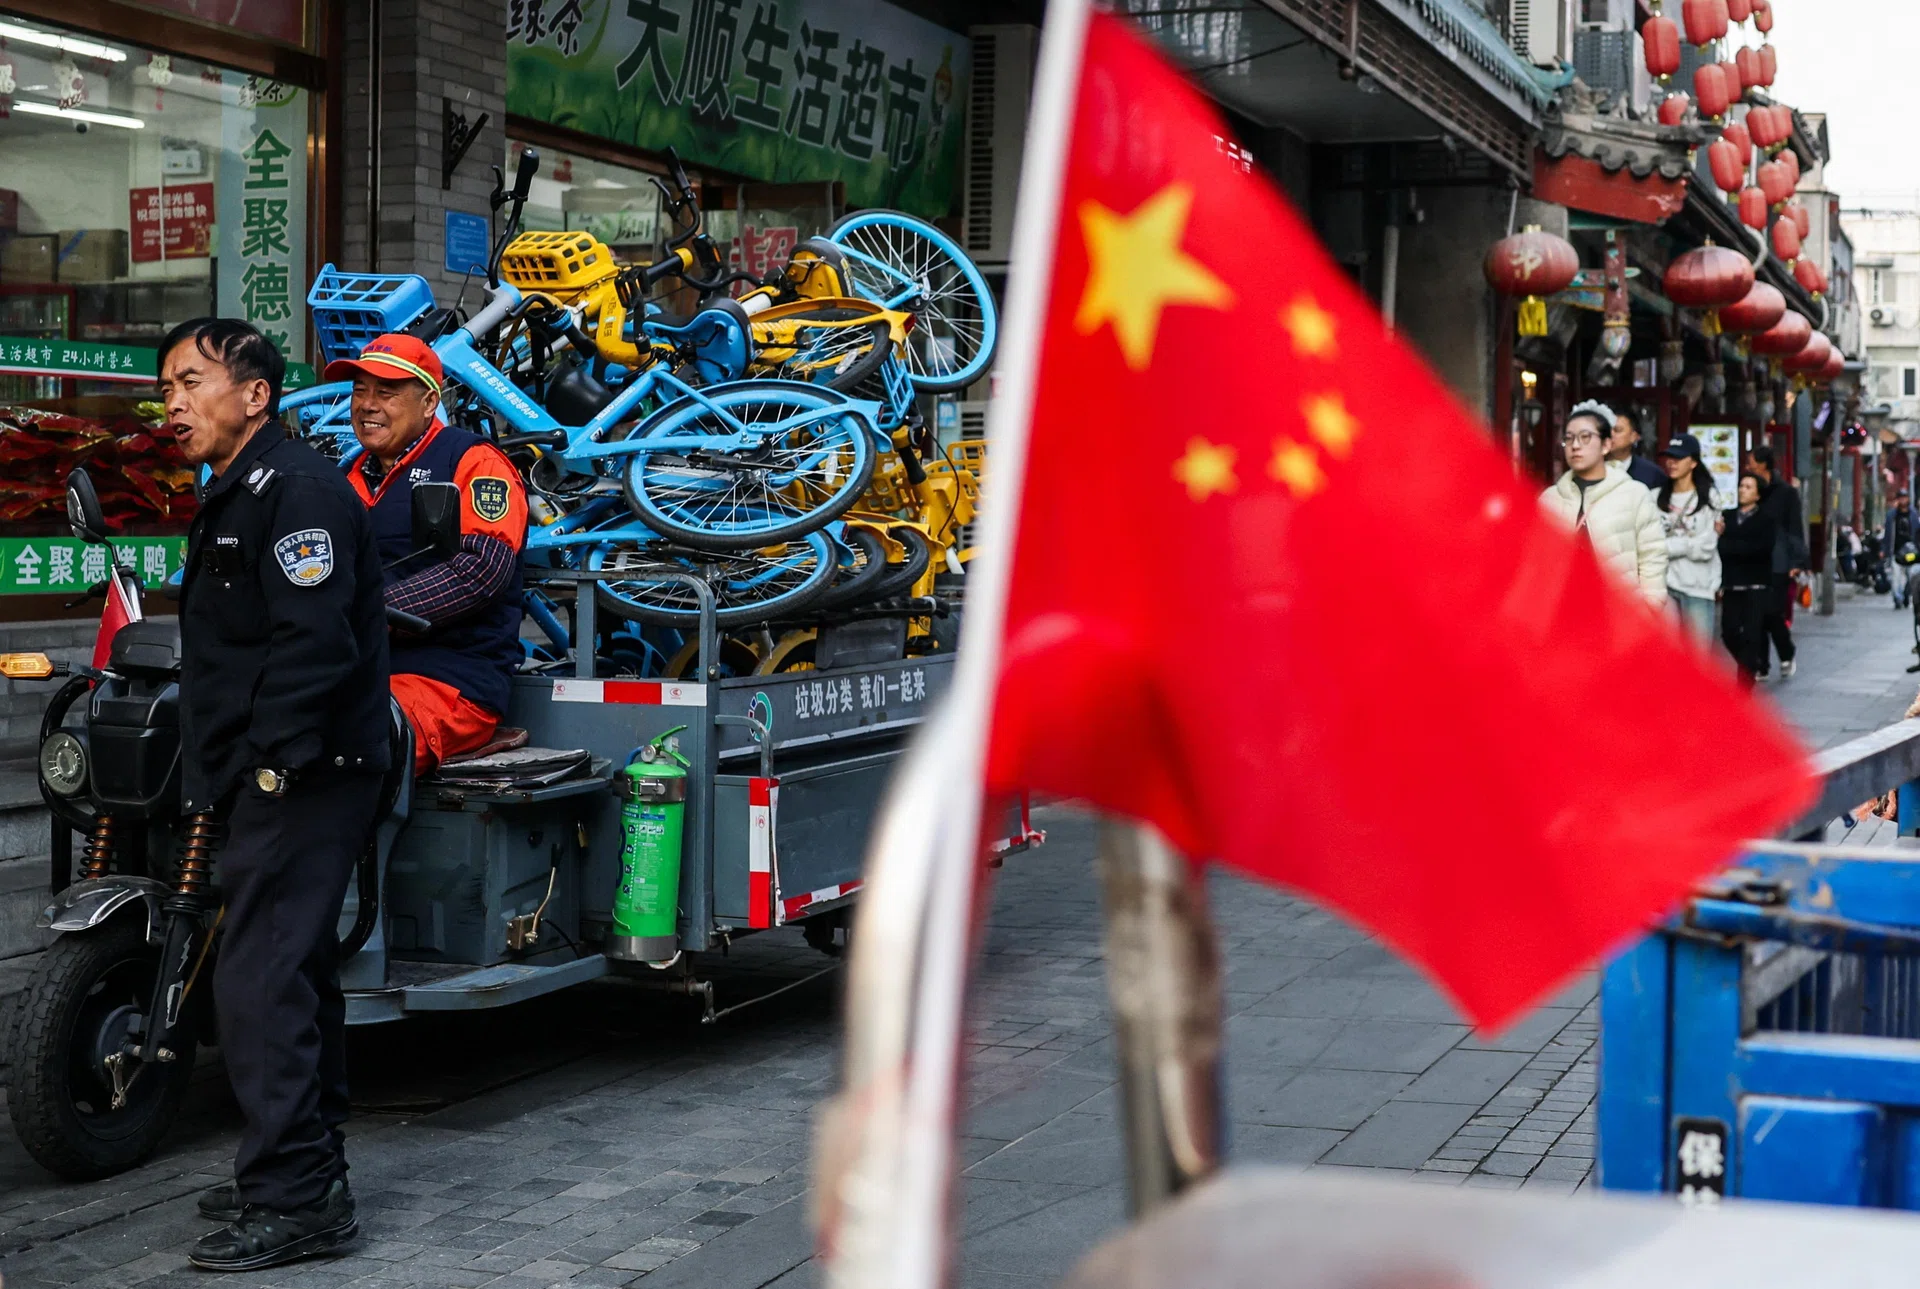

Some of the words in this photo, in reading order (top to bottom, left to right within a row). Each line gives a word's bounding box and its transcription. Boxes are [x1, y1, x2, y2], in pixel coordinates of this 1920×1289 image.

[240, 129, 292, 361] 全聚德
[62, 350, 133, 369] 24小时营业
[278, 532, 326, 554] 中华人民共和国
[284, 551, 297, 565] 保
[314, 543, 327, 556] 安
[14, 544, 167, 585] 全聚德烤鸭
[795, 677, 853, 719] 垃圾分类
[860, 667, 926, 709] 我们一起来
